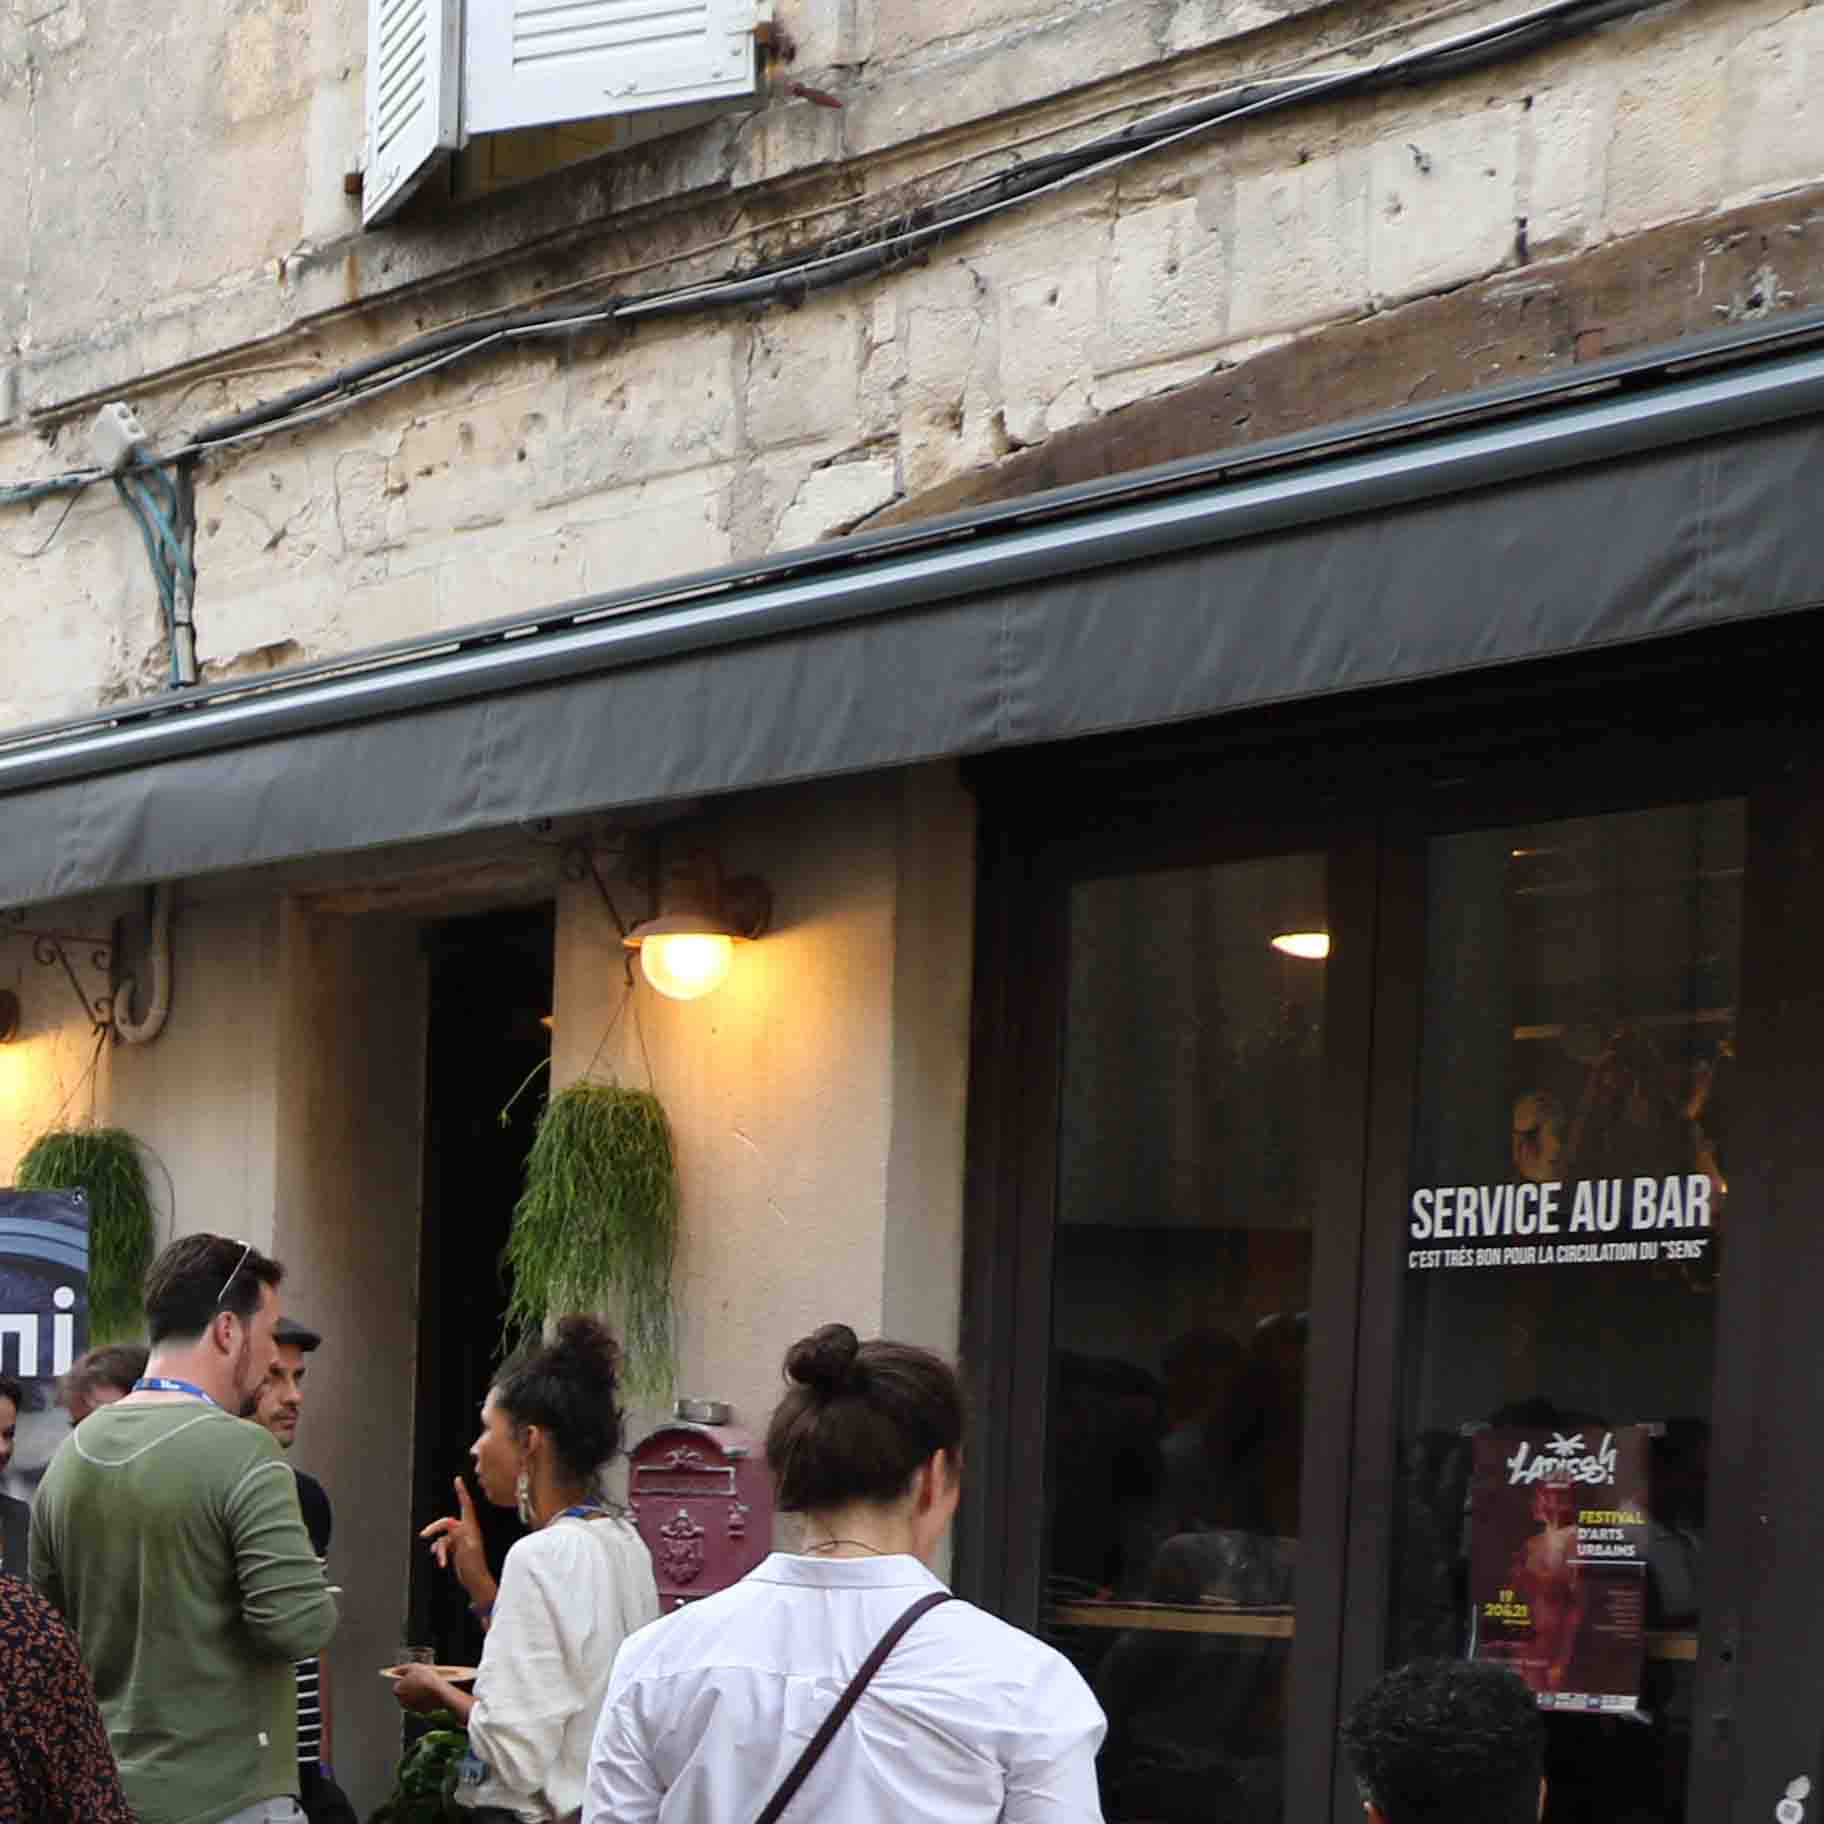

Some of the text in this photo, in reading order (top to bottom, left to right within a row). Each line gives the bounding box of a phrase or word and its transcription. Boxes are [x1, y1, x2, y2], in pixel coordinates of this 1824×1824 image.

[1411, 1174, 1712, 1239] SERVICE AU BAR
[1503, 1246, 1536, 1264] POUR
[1538, 1245, 1555, 1264] LA
[1556, 1242, 1638, 1263] CIRCULATION
[1639, 1241, 1659, 1260] DU
[1578, 1510, 1647, 1525] FESTIVAL
[1577, 1527, 1625, 1541] D'ARTS
[1577, 1543, 1636, 1557] URBAINS
